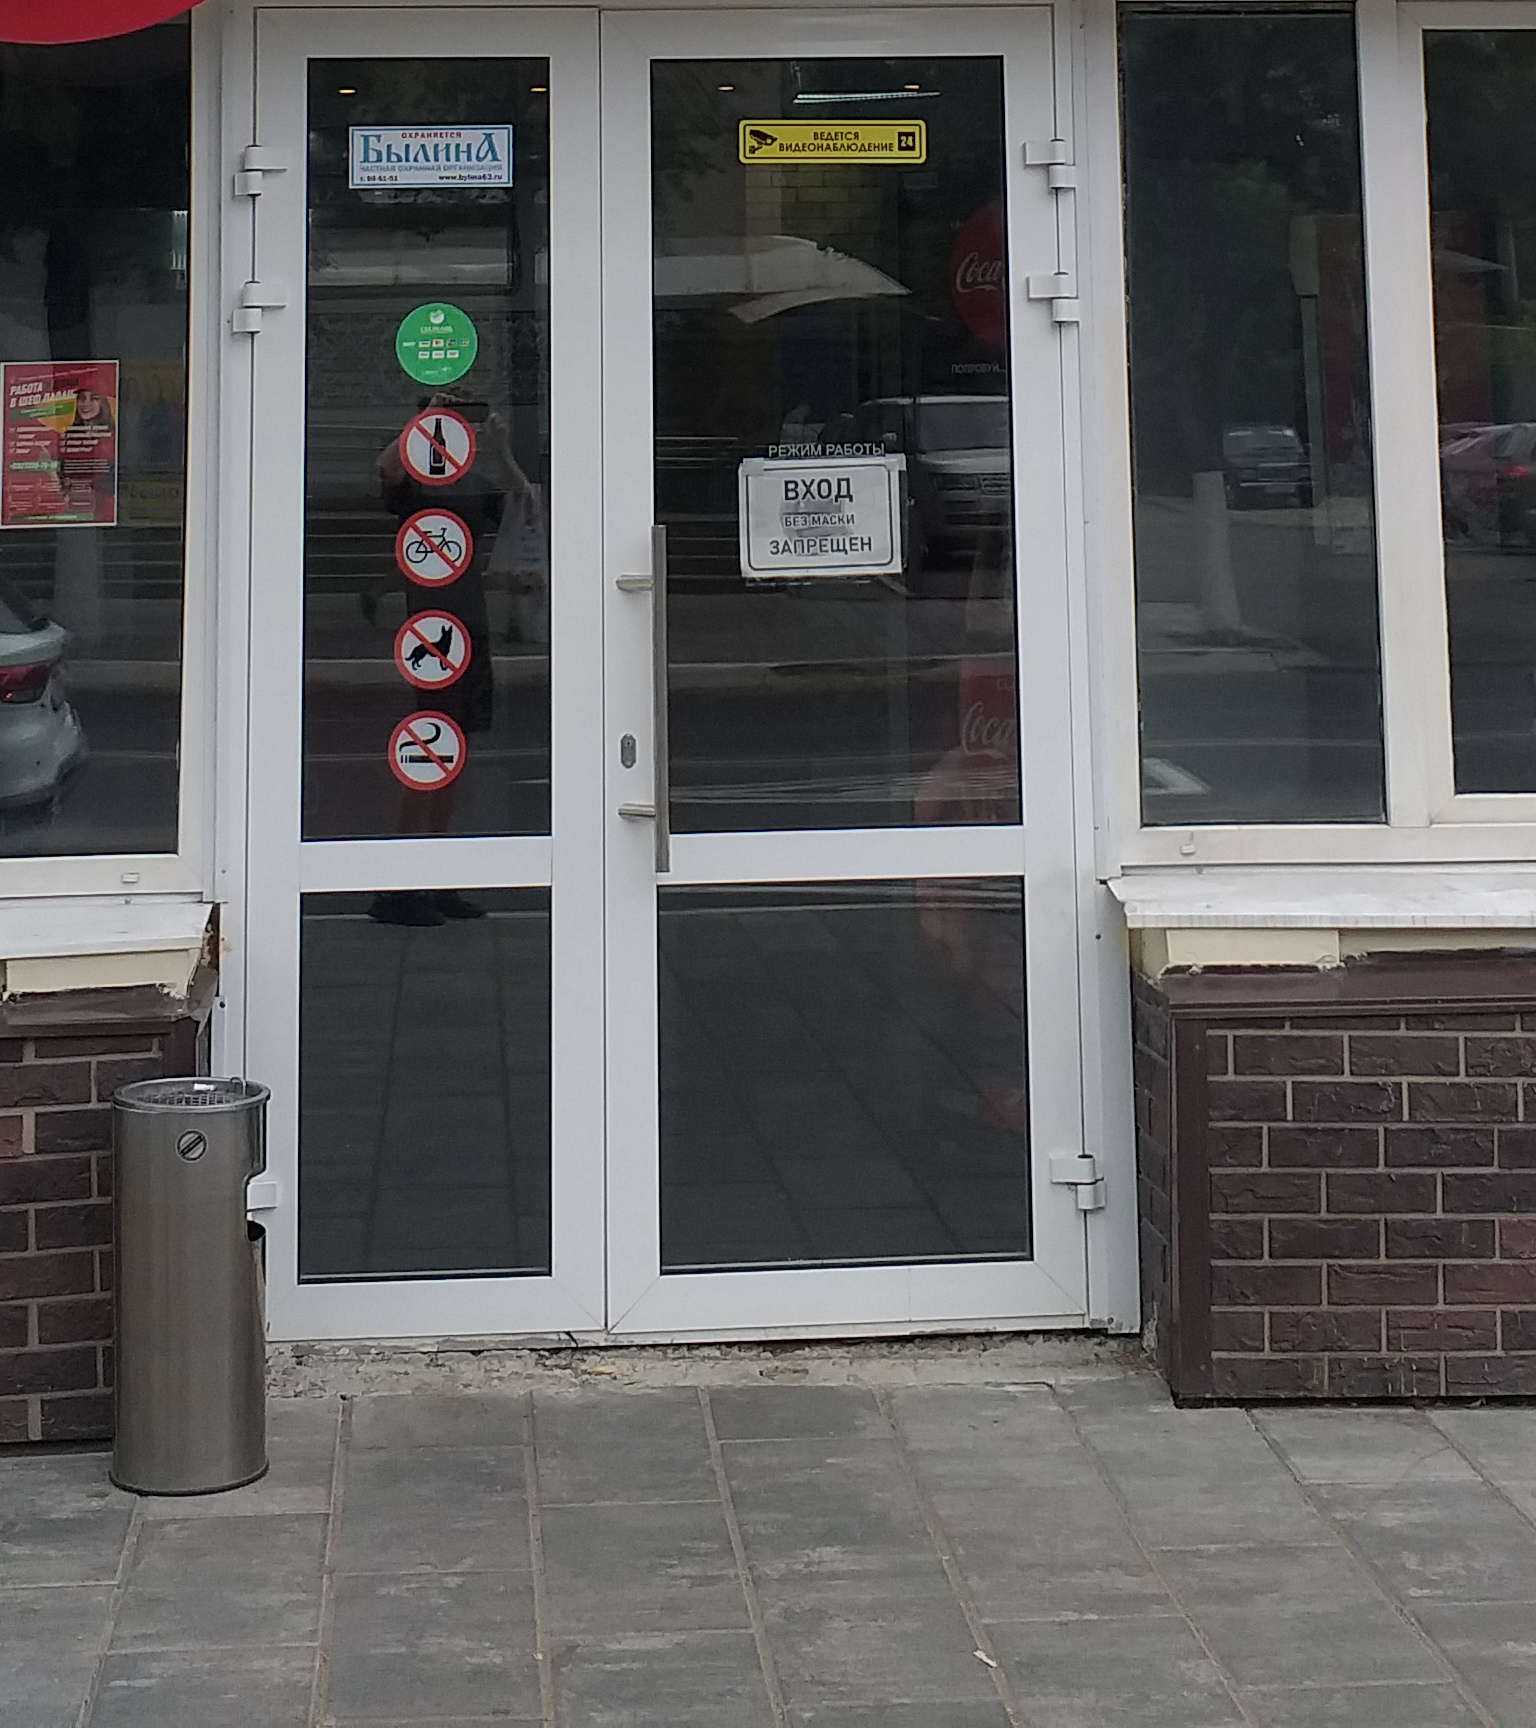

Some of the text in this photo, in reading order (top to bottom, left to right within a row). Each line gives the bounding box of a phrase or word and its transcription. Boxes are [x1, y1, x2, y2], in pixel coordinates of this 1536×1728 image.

[401, 131, 462, 139] ОХРАНЯЕТСЯ
[813, 131, 860, 141] ВЕДЕТСЯ
[778, 135, 914, 153] ВИДЕОНАБЛЮДЕНИЕ 24
[398, 164, 441, 172] ОХРАННАЯ
[768, 442, 885, 458] РЕЖИМ РАБОТЫ
[783, 477, 854, 504] ВХОД
[784, 513, 855, 528] БЕЗ МАСКИ
[769, 536, 872, 556] ЗАПРЕЩЕН
